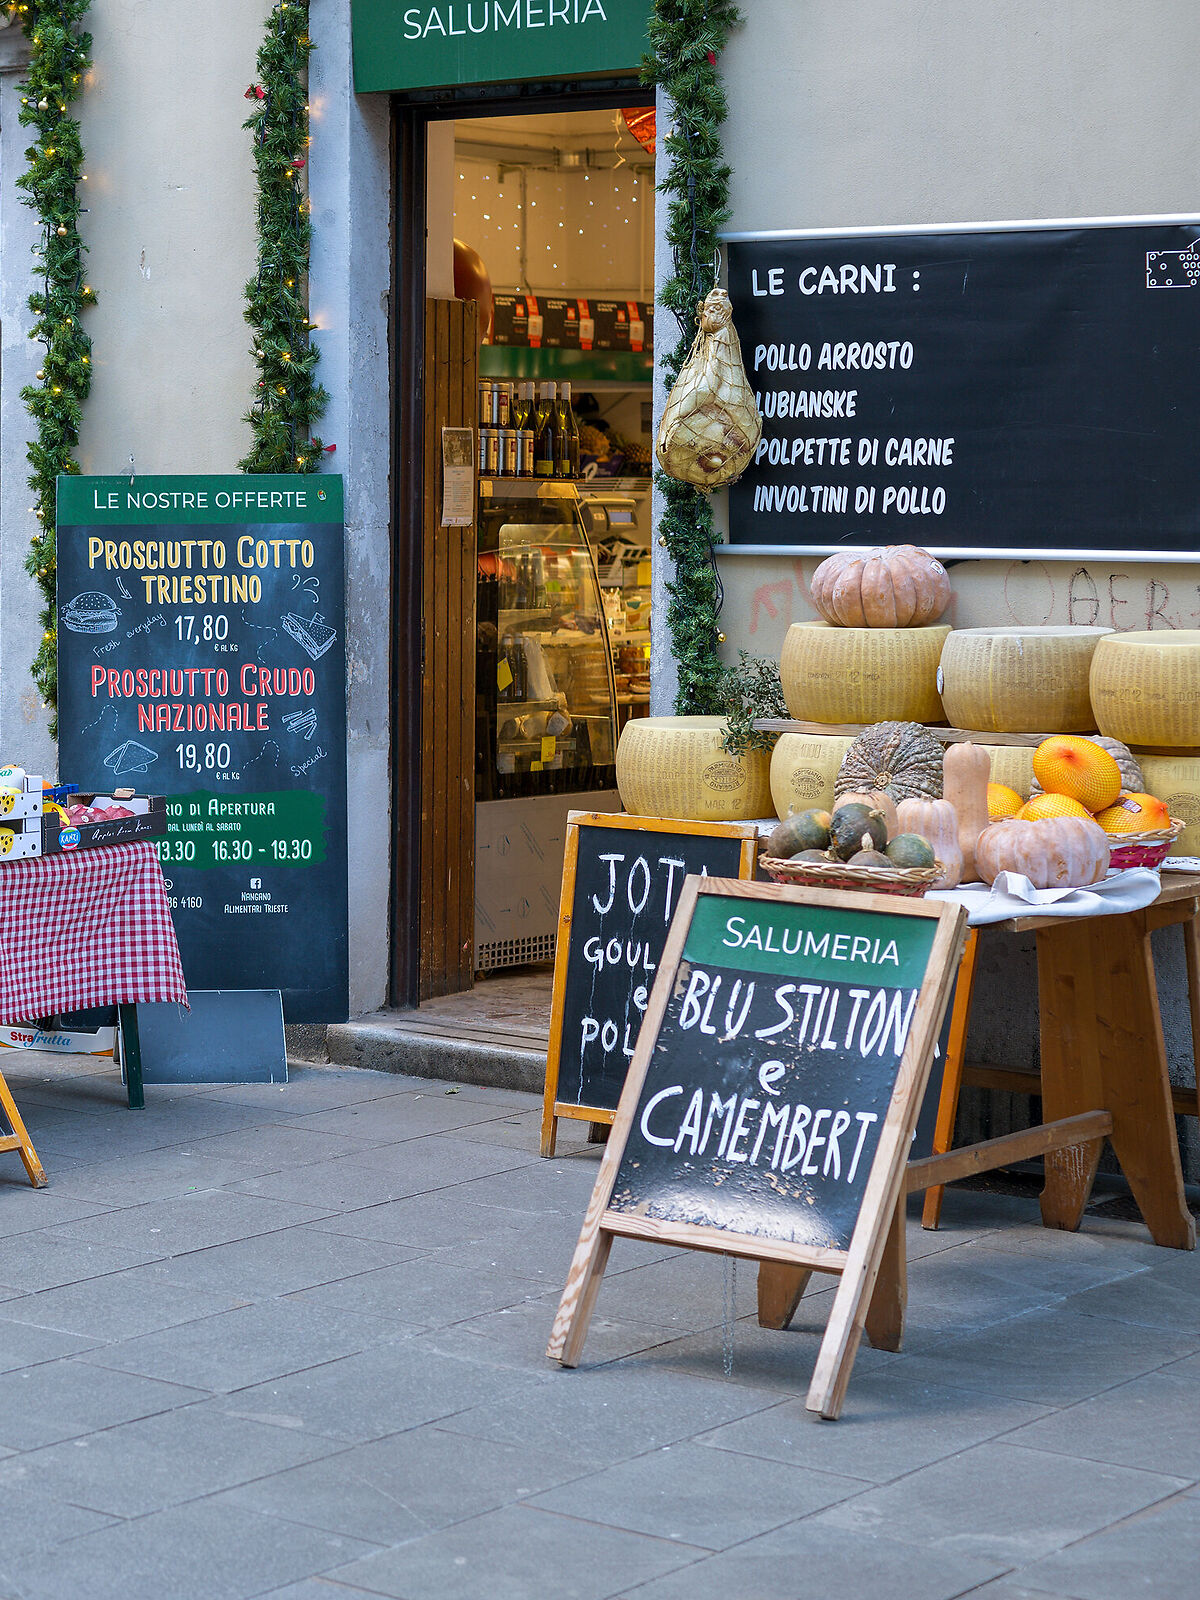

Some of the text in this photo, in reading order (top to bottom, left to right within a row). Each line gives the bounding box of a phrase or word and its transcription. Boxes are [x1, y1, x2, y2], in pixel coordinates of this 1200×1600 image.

[403, 0, 607, 40] SALUMERIA
[752, 264, 897, 297] LE CARNI
[754, 341, 914, 372] POLLO ARROSTO
[756, 390, 858, 418] LUBIANSKE
[756, 438, 955, 467] POLPETTE DI CARNE
[94, 490, 307, 509] LE NOSTRE OFFERTE
[753, 485, 946, 516] INVOLTINI DI POLLO
[88, 536, 315, 570] PROSCIUTTO COTTO
[142, 574, 262, 605] TRIESTINO
[93, 612, 167, 657] Fresh everyday
[174, 614, 229, 646] 17,80
[91, 664, 315, 697] PROSCIUTTO CRUDO
[138, 702, 269, 732] NAZIONALE
[175, 743, 231, 773] 19,80
[290, 746, 328, 777] Special
[166, 799, 276, 816] RIO DI APERTURA
[216, 822, 241, 832] SABATO
[212, 839, 253, 861] 16.30
[270, 839, 313, 861] 19.30
[181, 896, 202, 909] 4160
[591, 854, 707, 927] JOT
[224, 904, 288, 914] ALIMENTARI TRIESTE
[722, 915, 900, 967] SALUMERIA
[679, 970, 918, 1058] BLU STILTON
[10, 1031, 71, 1048] Strafrutta
[759, 1060, 786, 1096] e
[640, 1085, 878, 1184] CAMEMBERT
